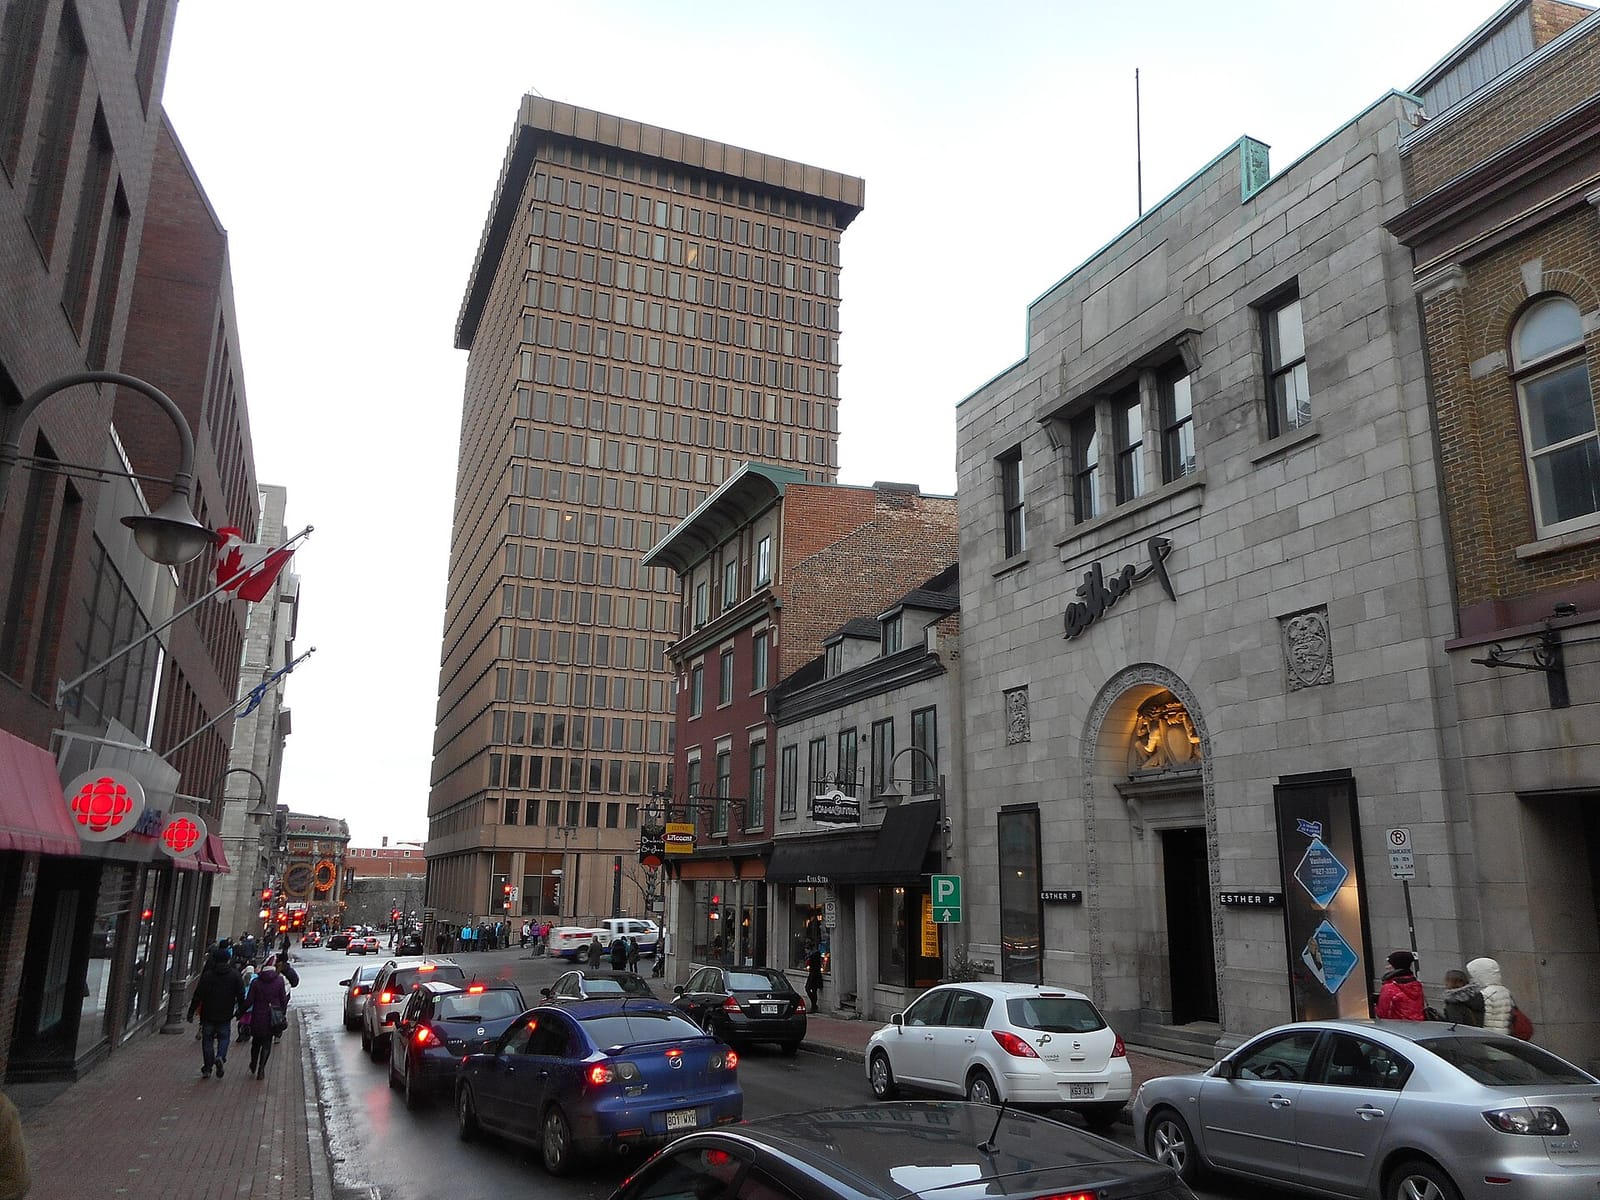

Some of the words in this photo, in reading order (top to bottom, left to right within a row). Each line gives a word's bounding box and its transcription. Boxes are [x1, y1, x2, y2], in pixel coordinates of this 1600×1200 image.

[938, 879, 955, 903] P
[1041, 892, 1067, 900] ESTHER
[1220, 895, 1261, 904] ESTHER
[1268, 896, 1275, 904] P
